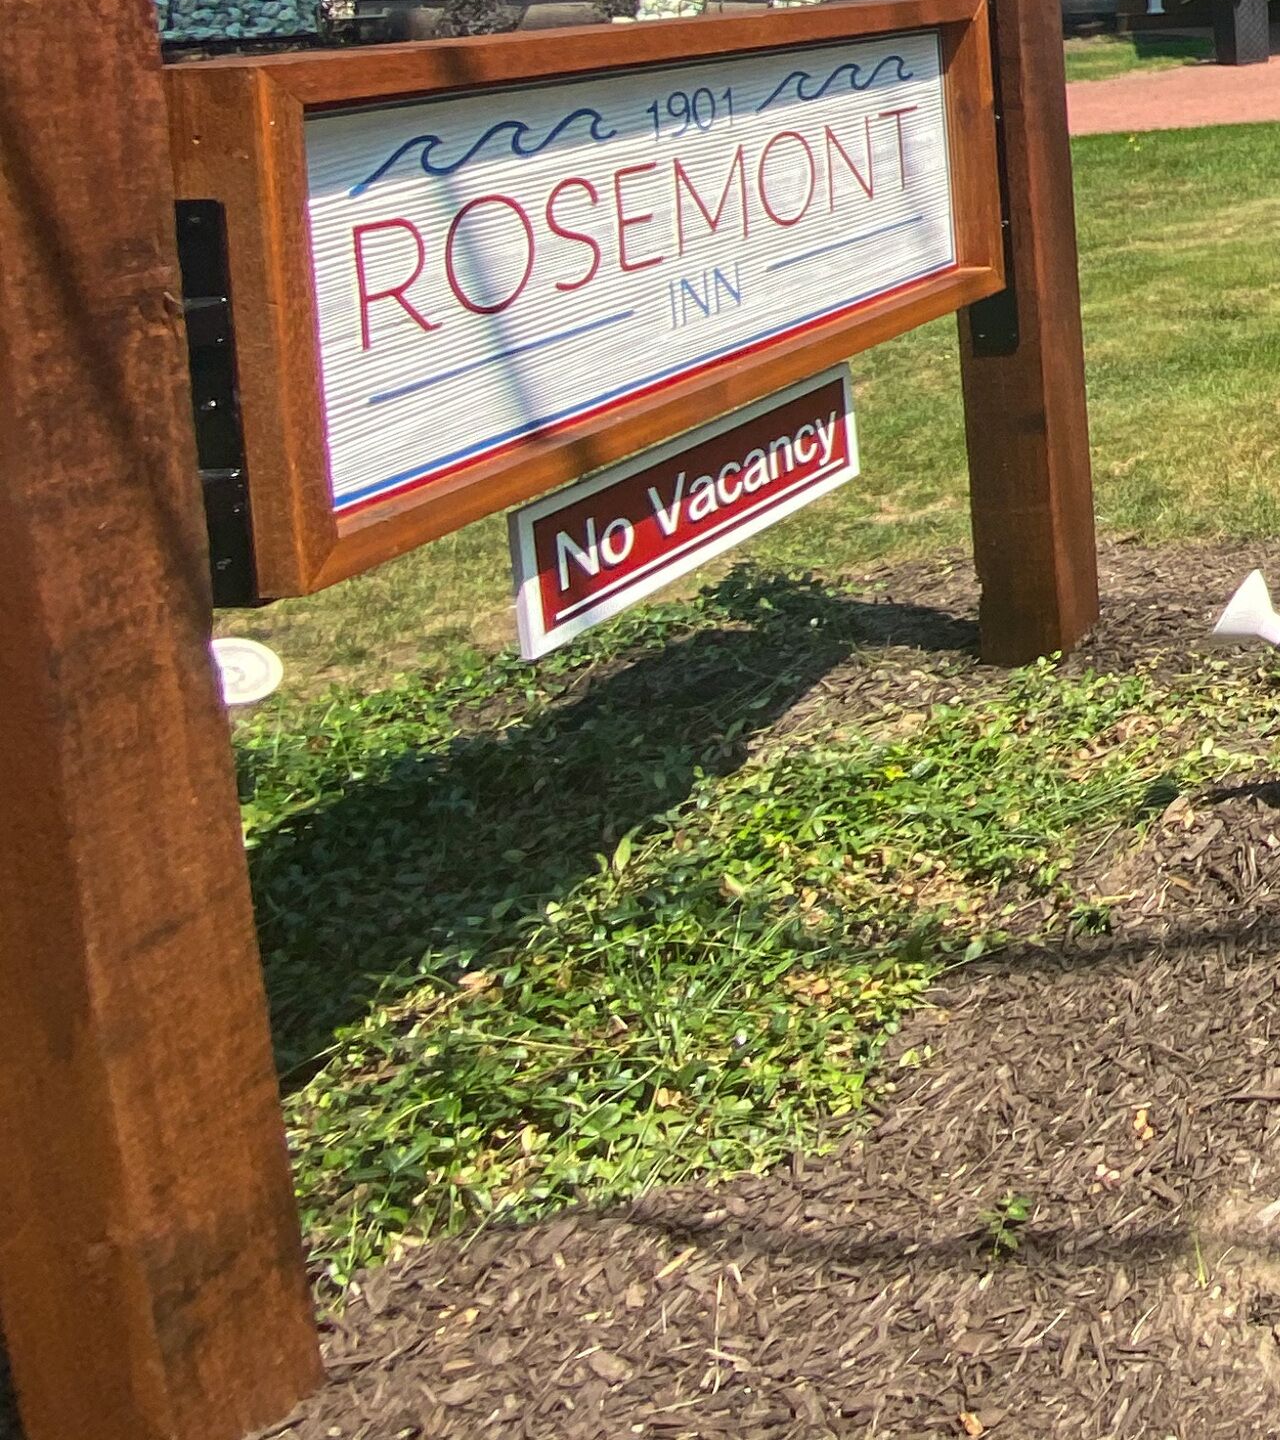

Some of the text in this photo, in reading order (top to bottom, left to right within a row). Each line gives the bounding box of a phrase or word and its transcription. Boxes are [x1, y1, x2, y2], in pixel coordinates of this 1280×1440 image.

[647, 86, 736, 141] 1901
[352, 105, 918, 350] ROSEMONT
[669, 262, 743, 330] INN
[555, 410, 837, 592] No Vacancy
